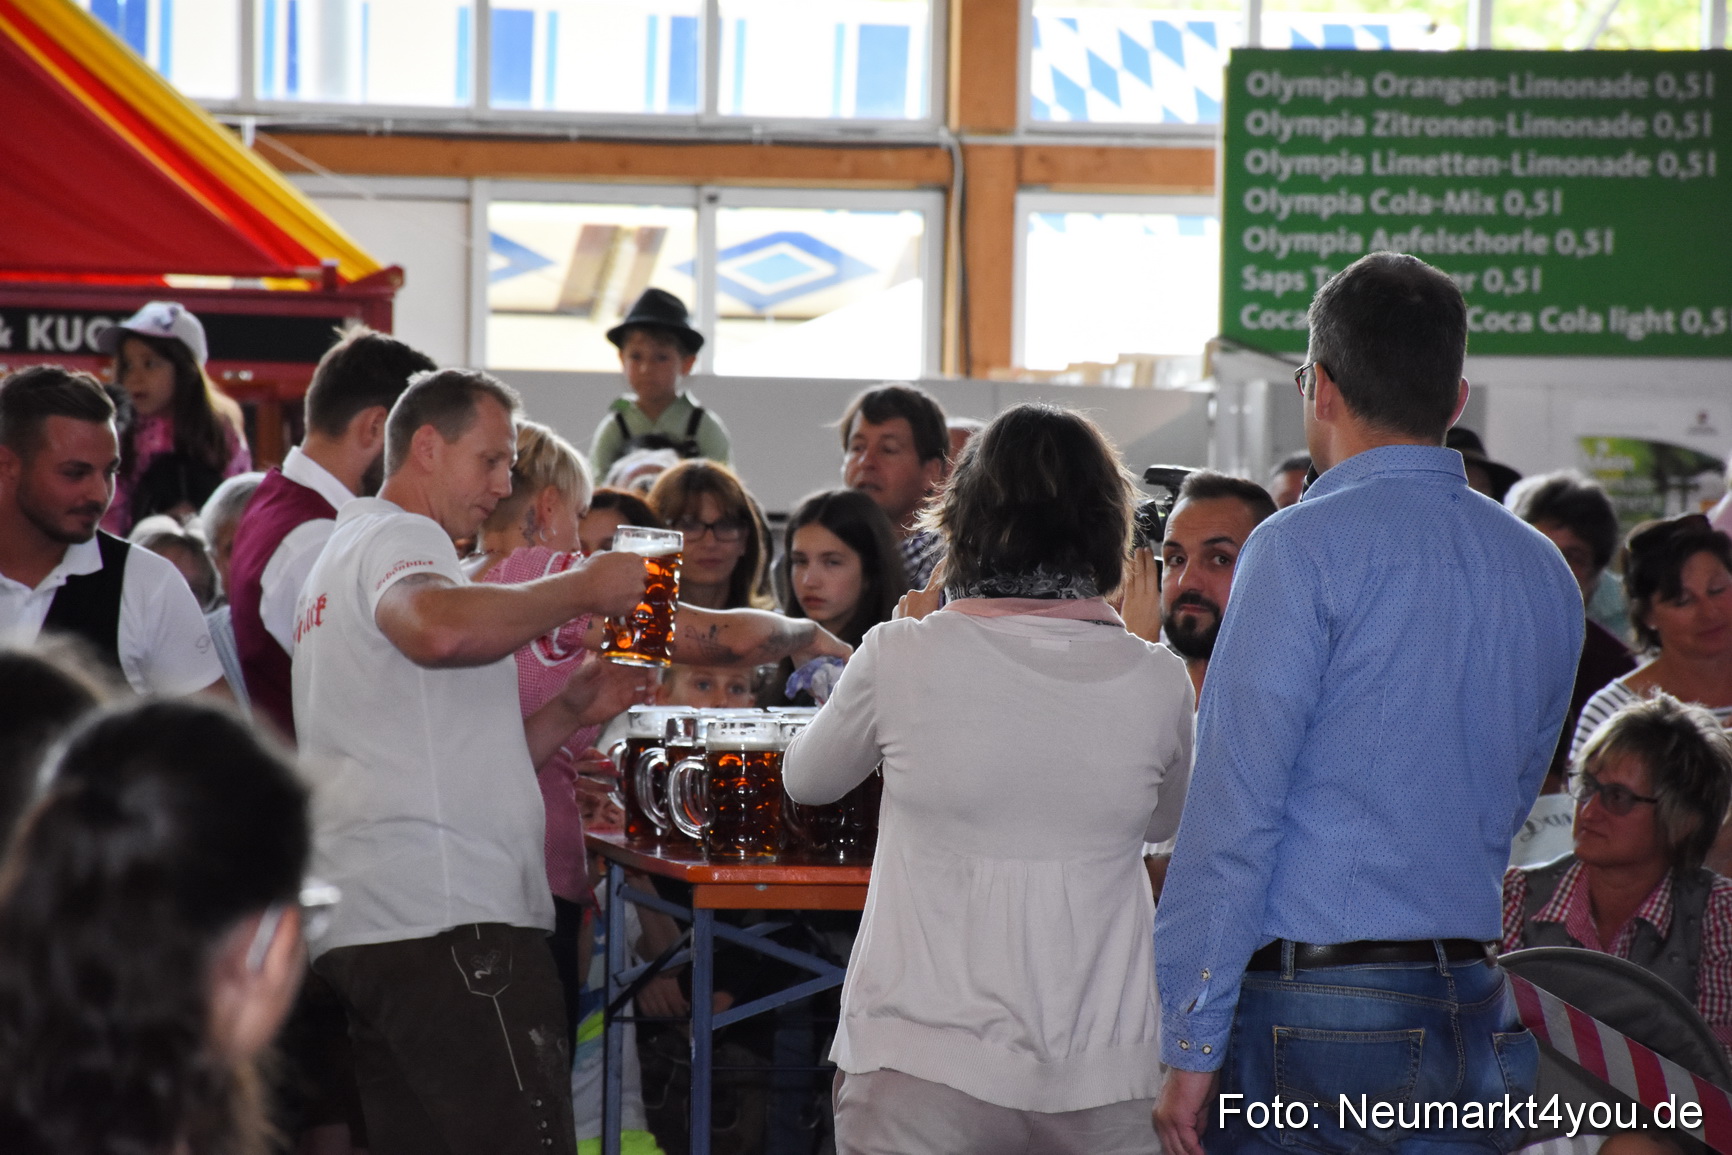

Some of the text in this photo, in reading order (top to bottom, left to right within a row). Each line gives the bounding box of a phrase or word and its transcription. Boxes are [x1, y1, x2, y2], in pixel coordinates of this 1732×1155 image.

[1245, 70, 1366, 103] Olympia
[1373, 70, 1649, 104] Orangen-Limonade
[1244, 109, 1366, 143] Olympia
[1372, 110, 1647, 138] Zitronen-Limonade
[1244, 148, 1366, 181] Olympia
[1372, 149, 1652, 177] Limetten-Limonade
[1243, 187, 1364, 220] Olympia
[1370, 188, 1497, 215] Cola-Mix
[1243, 226, 1364, 259] Olympia
[1369, 227, 1549, 256] Apfelschorle
[1242, 264, 1307, 297] Saps
[1240, 303, 1309, 331] Coca
[1466, 305, 1533, 333] Coca
[1540, 305, 1604, 333] Cola
[1609, 305, 1675, 341] light
